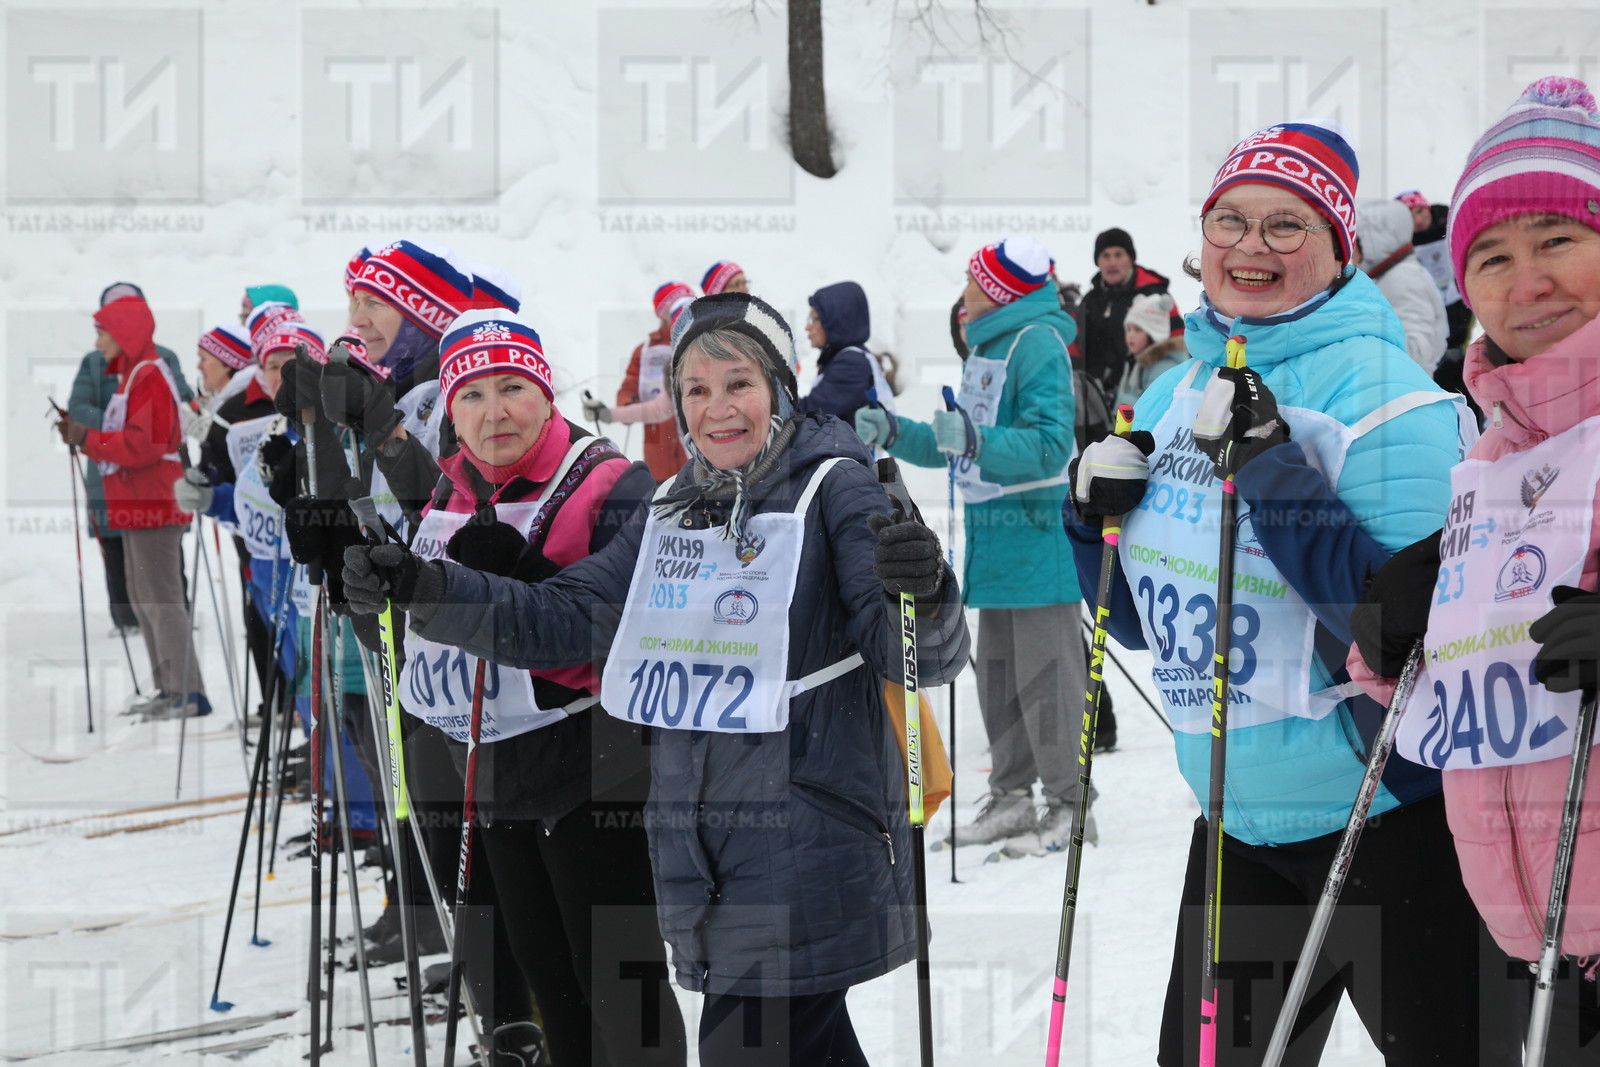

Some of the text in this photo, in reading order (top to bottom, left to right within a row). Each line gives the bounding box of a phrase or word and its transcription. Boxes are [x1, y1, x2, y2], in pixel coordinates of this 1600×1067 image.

[1245, 373, 1259, 401] LEKI
[1217, 449, 1225, 467] LEKI
[1138, 480, 1206, 524] 2023
[1129, 544, 1162, 566] СПОРТ
[1166, 555, 1218, 585] НОРМА
[902, 597, 917, 694] Larsen
[627, 658, 755, 729] 10072
[907, 723, 919, 787] ACTIVE
